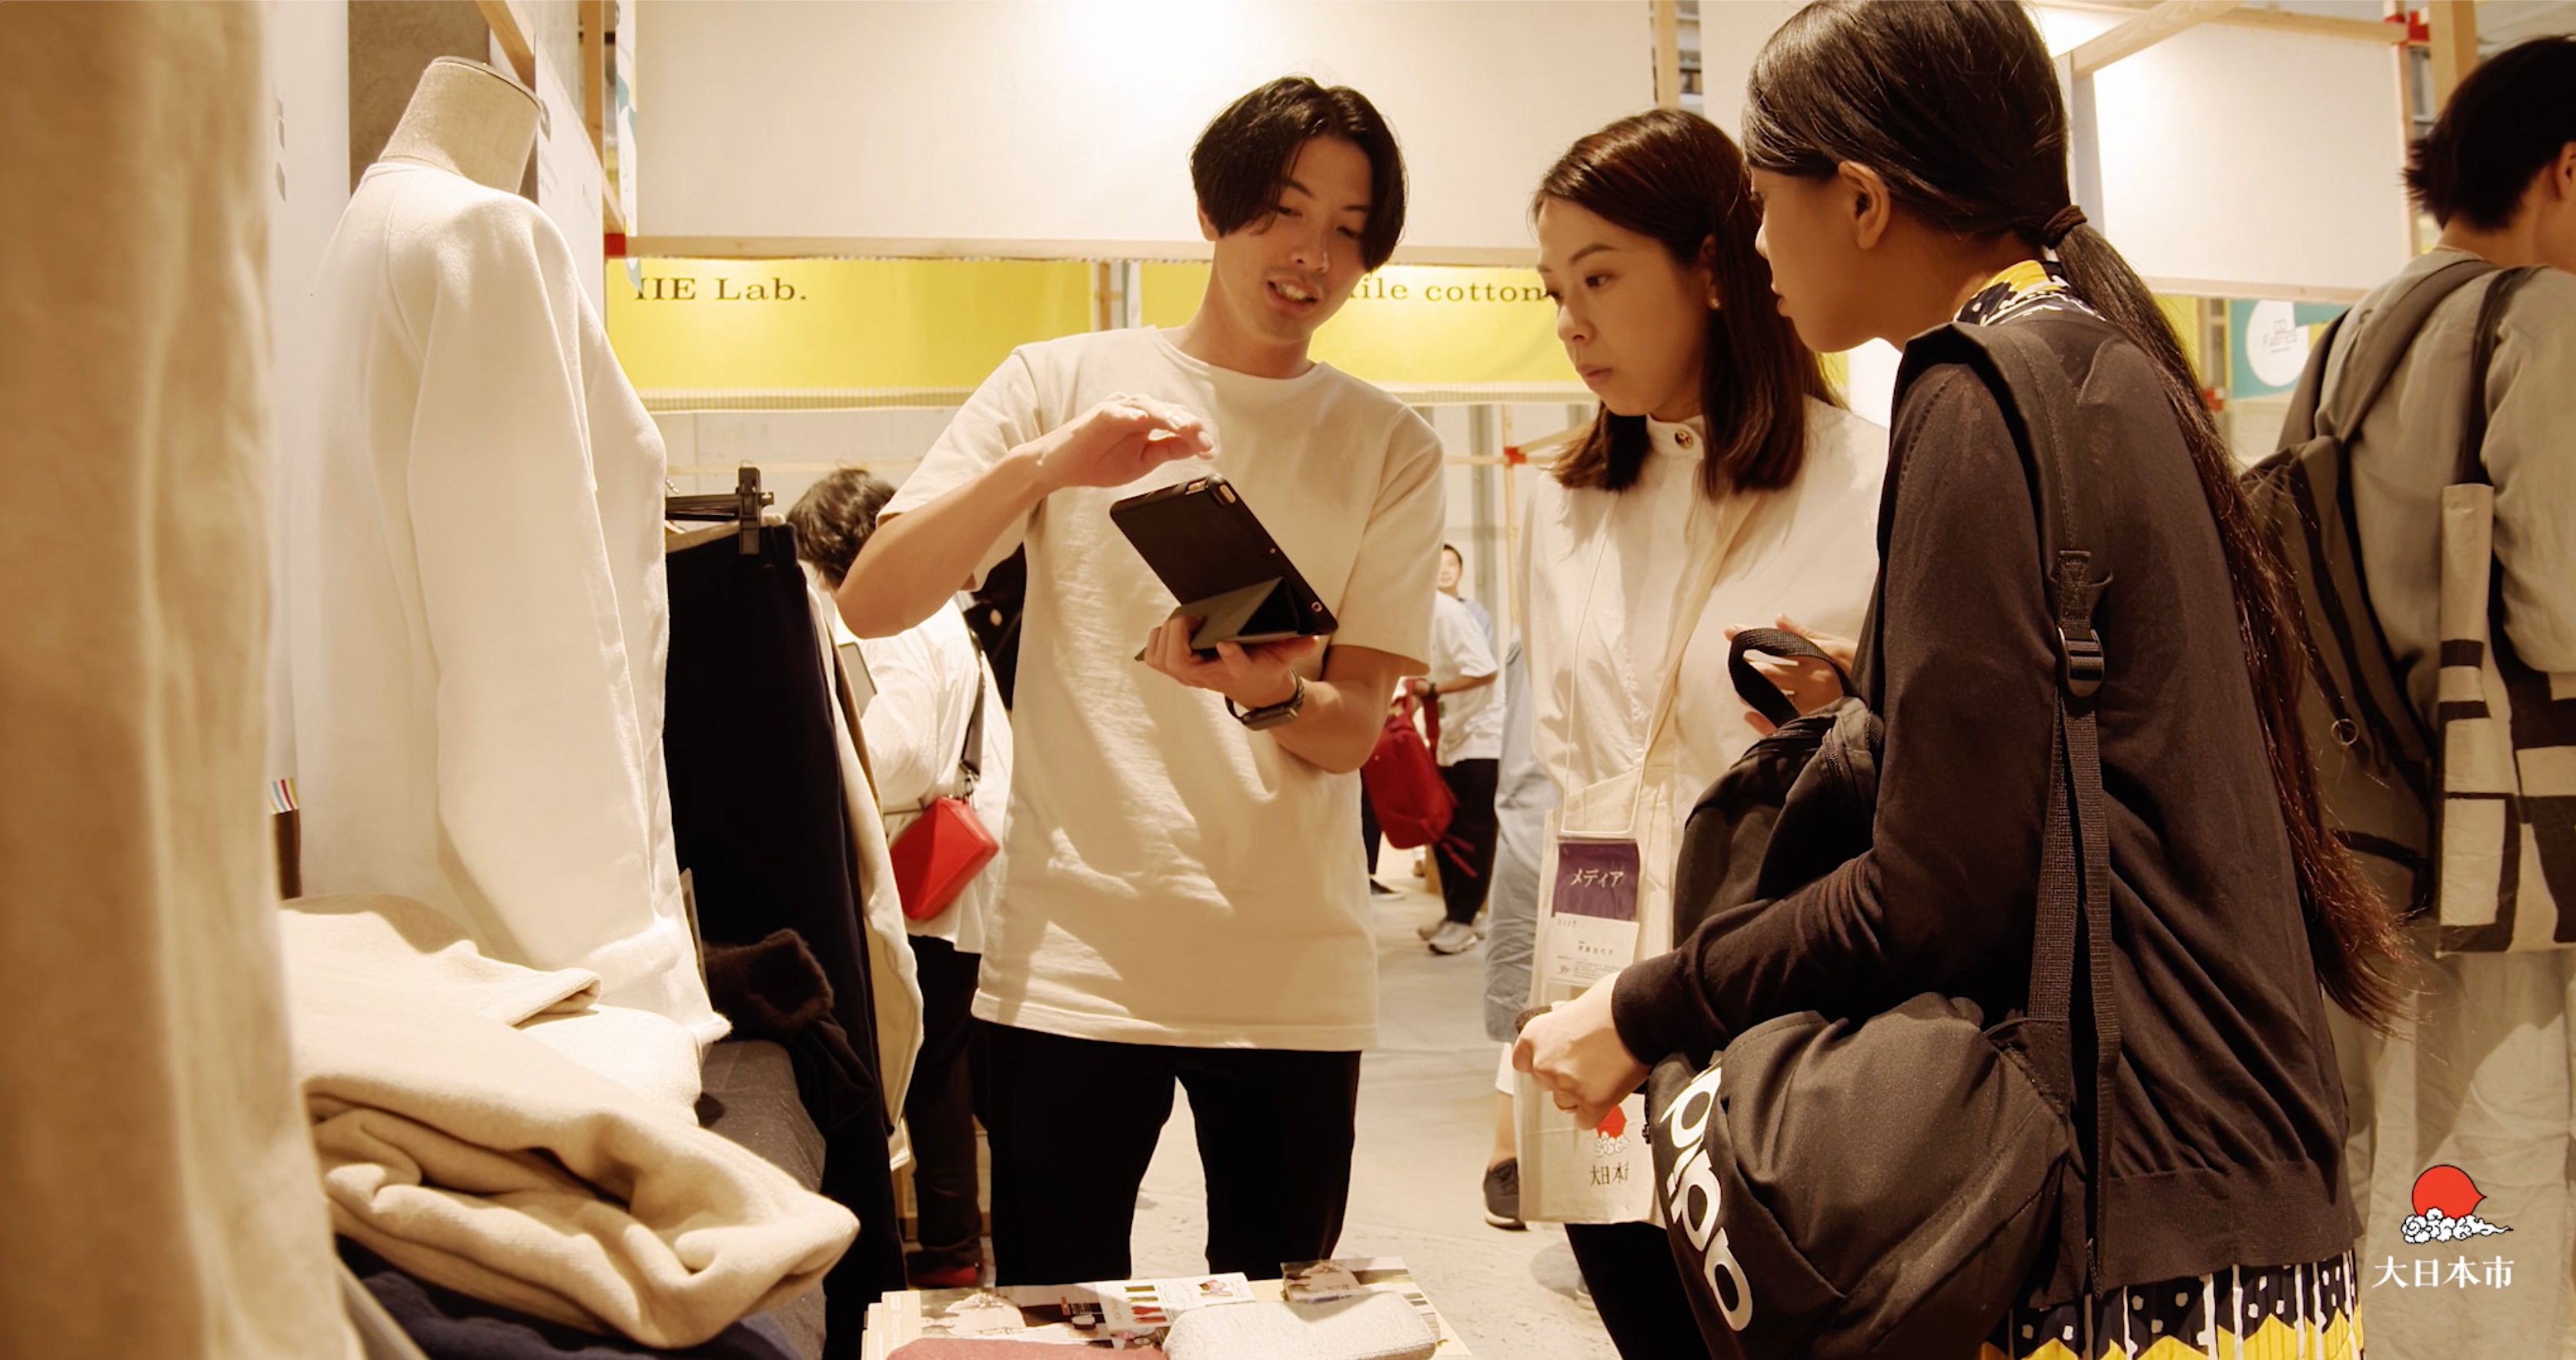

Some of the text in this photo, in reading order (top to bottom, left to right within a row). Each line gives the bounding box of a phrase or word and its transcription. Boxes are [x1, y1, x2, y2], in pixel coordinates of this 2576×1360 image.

[715, 277, 806, 301] Lab.
[1349, 277, 1547, 302] ile cotton
[1570, 868, 1624, 888] メディア
[1659, 1058, 1752, 1332] adid
